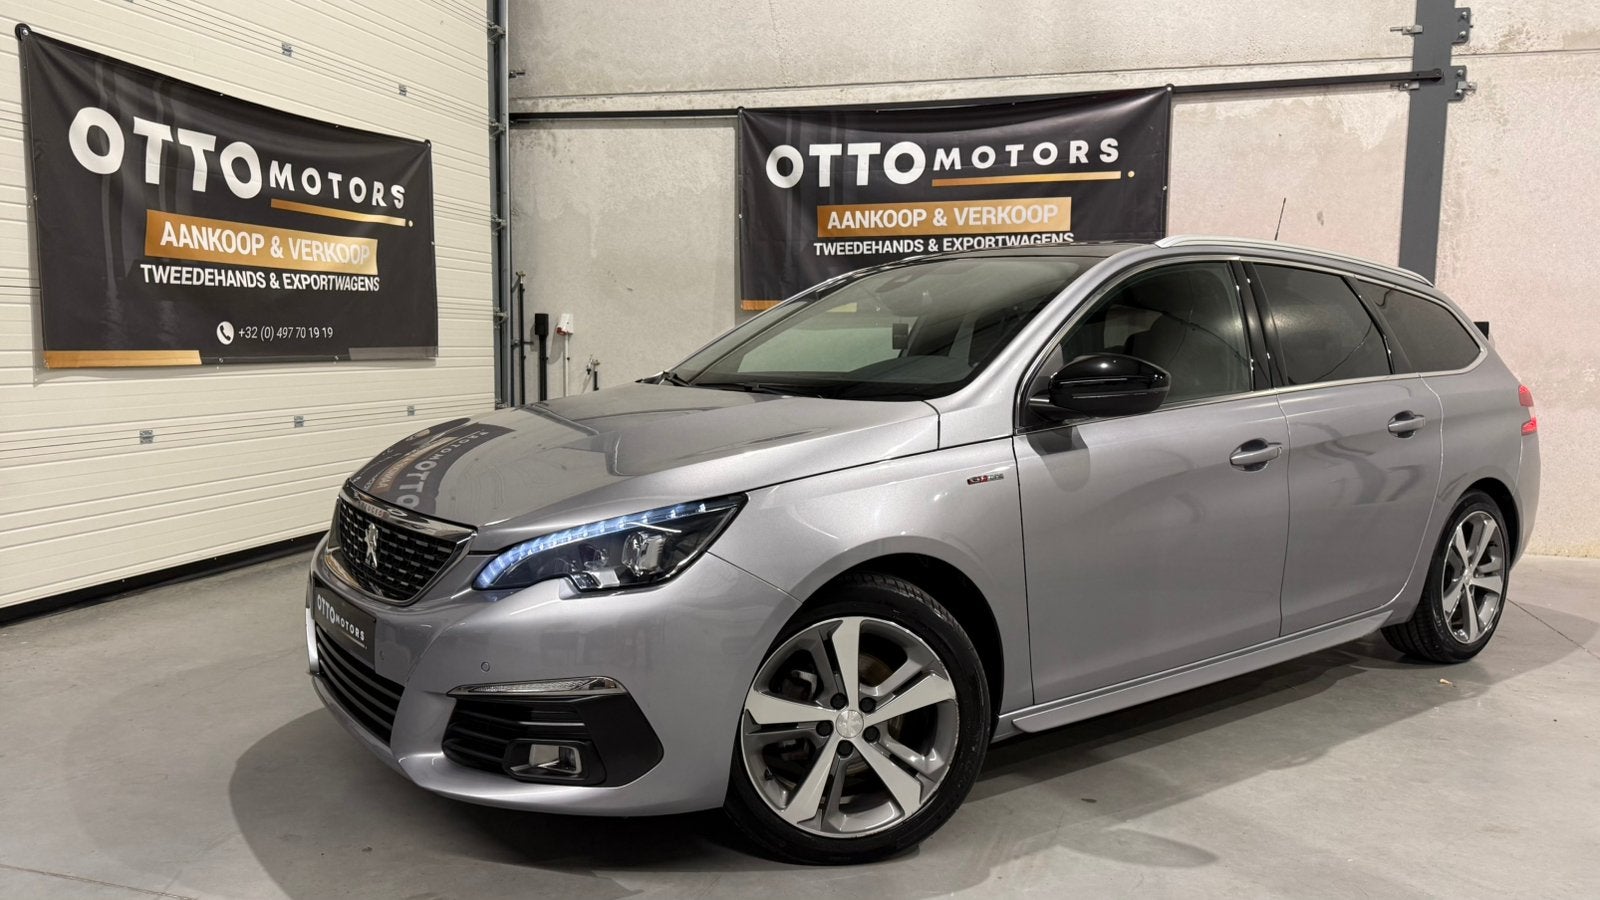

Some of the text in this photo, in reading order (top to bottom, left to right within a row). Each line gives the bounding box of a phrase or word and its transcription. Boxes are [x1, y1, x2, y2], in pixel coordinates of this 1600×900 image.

[68, 106, 406, 209] OTTO MOTORS
[765, 137, 1120, 189] OTTO MOTORS
[827, 204, 1060, 230] AANKOOP & VERKOOP
[160, 221, 370, 265] AANKOOP & VERKOOP
[813, 239, 924, 256] TWEEDEHANDS
[928, 239, 939, 252] &
[140, 264, 380, 292] TWEEDEHANDS & EXPORTWAGENS
[238, 325, 334, 342] +32 (0) 497 70 19 19
[317, 594, 365, 641] OTTO MOTORS
